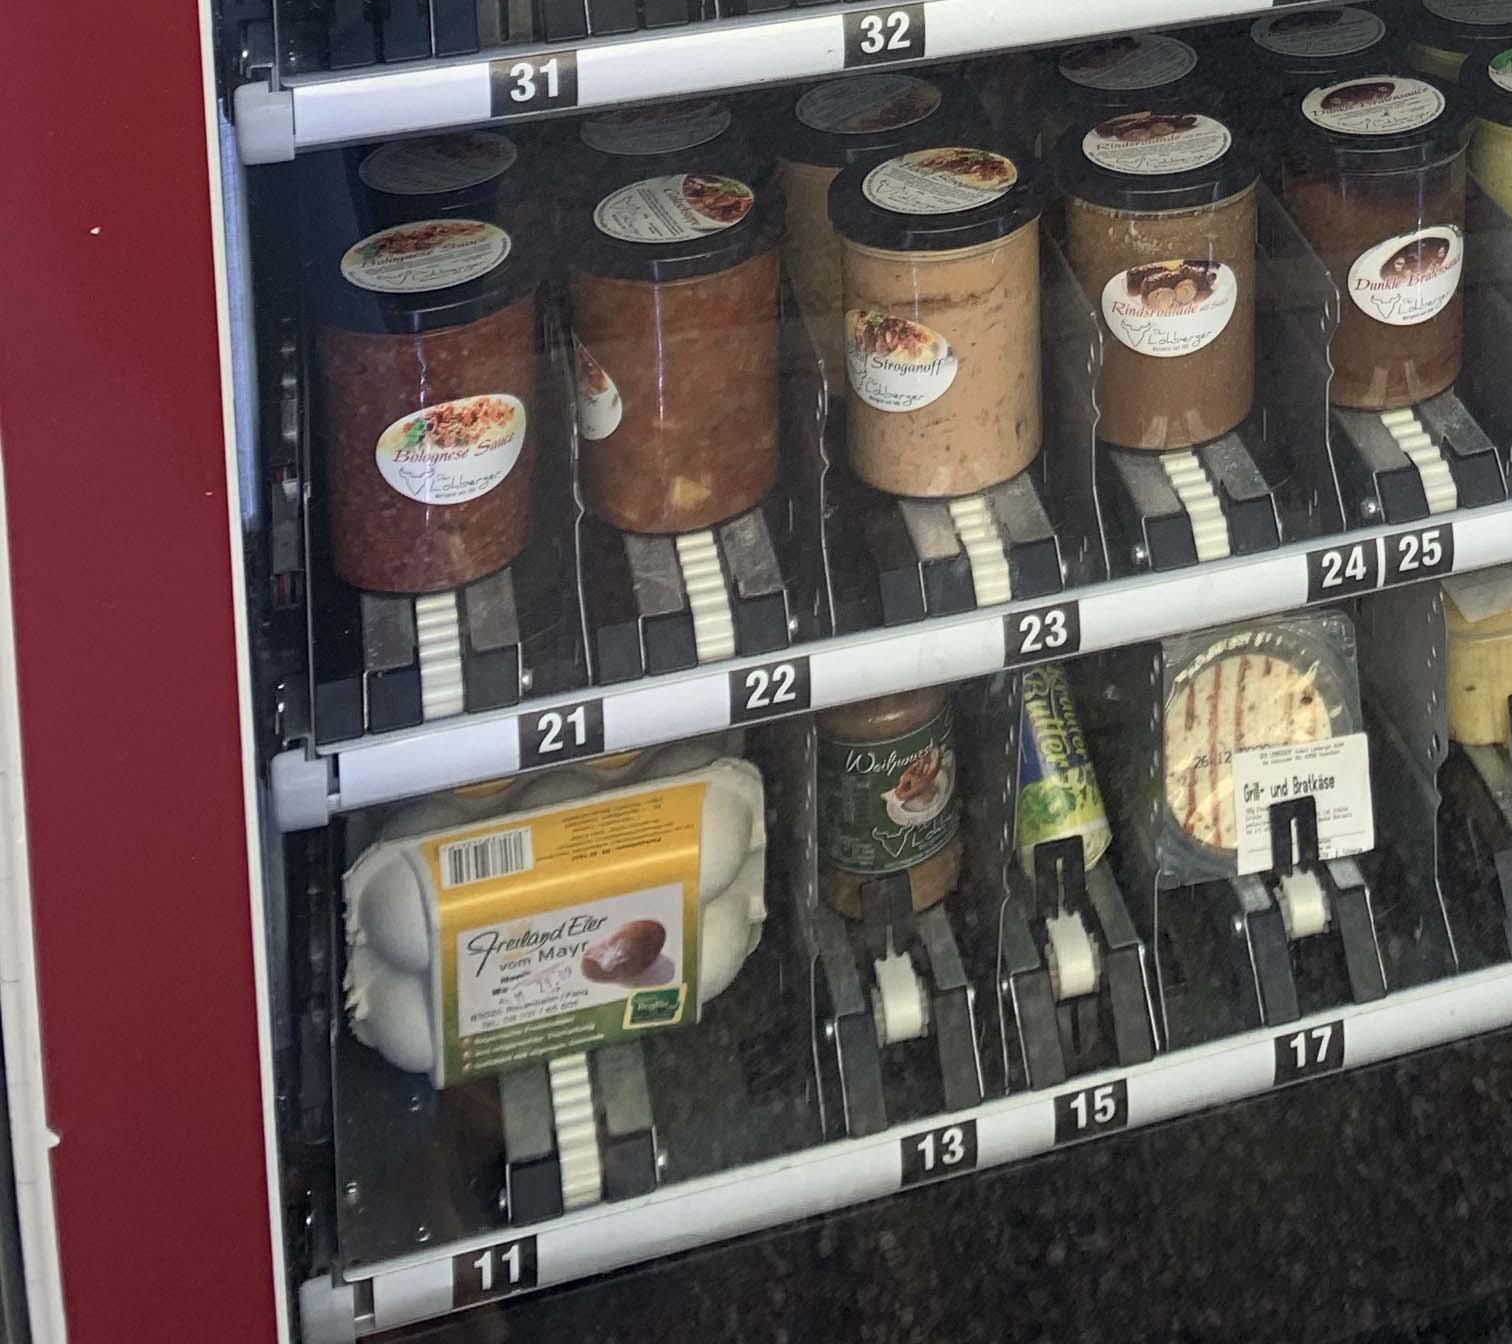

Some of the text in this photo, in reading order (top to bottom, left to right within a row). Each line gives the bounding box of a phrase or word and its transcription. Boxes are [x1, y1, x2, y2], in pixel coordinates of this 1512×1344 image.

[861, 8, 910, 53] 32
[510, 58, 559, 101] 31
[1322, 545, 1366, 587] 24
[1399, 530, 1441, 571] 25
[1020, 610, 1067, 653] 23
[746, 664, 795, 708] 22
[538, 706, 585, 752] 21
[1243, 774, 1336, 804] Grill- und Bratkäse
[567, 914, 609, 937] Eier
[499, 940, 591, 973] vom Mayr
[1291, 1026, 1332, 1067] 17
[1071, 1085, 1115, 1128] 15
[918, 1127, 964, 1169] 13
[474, 1244, 519, 1289] 11
